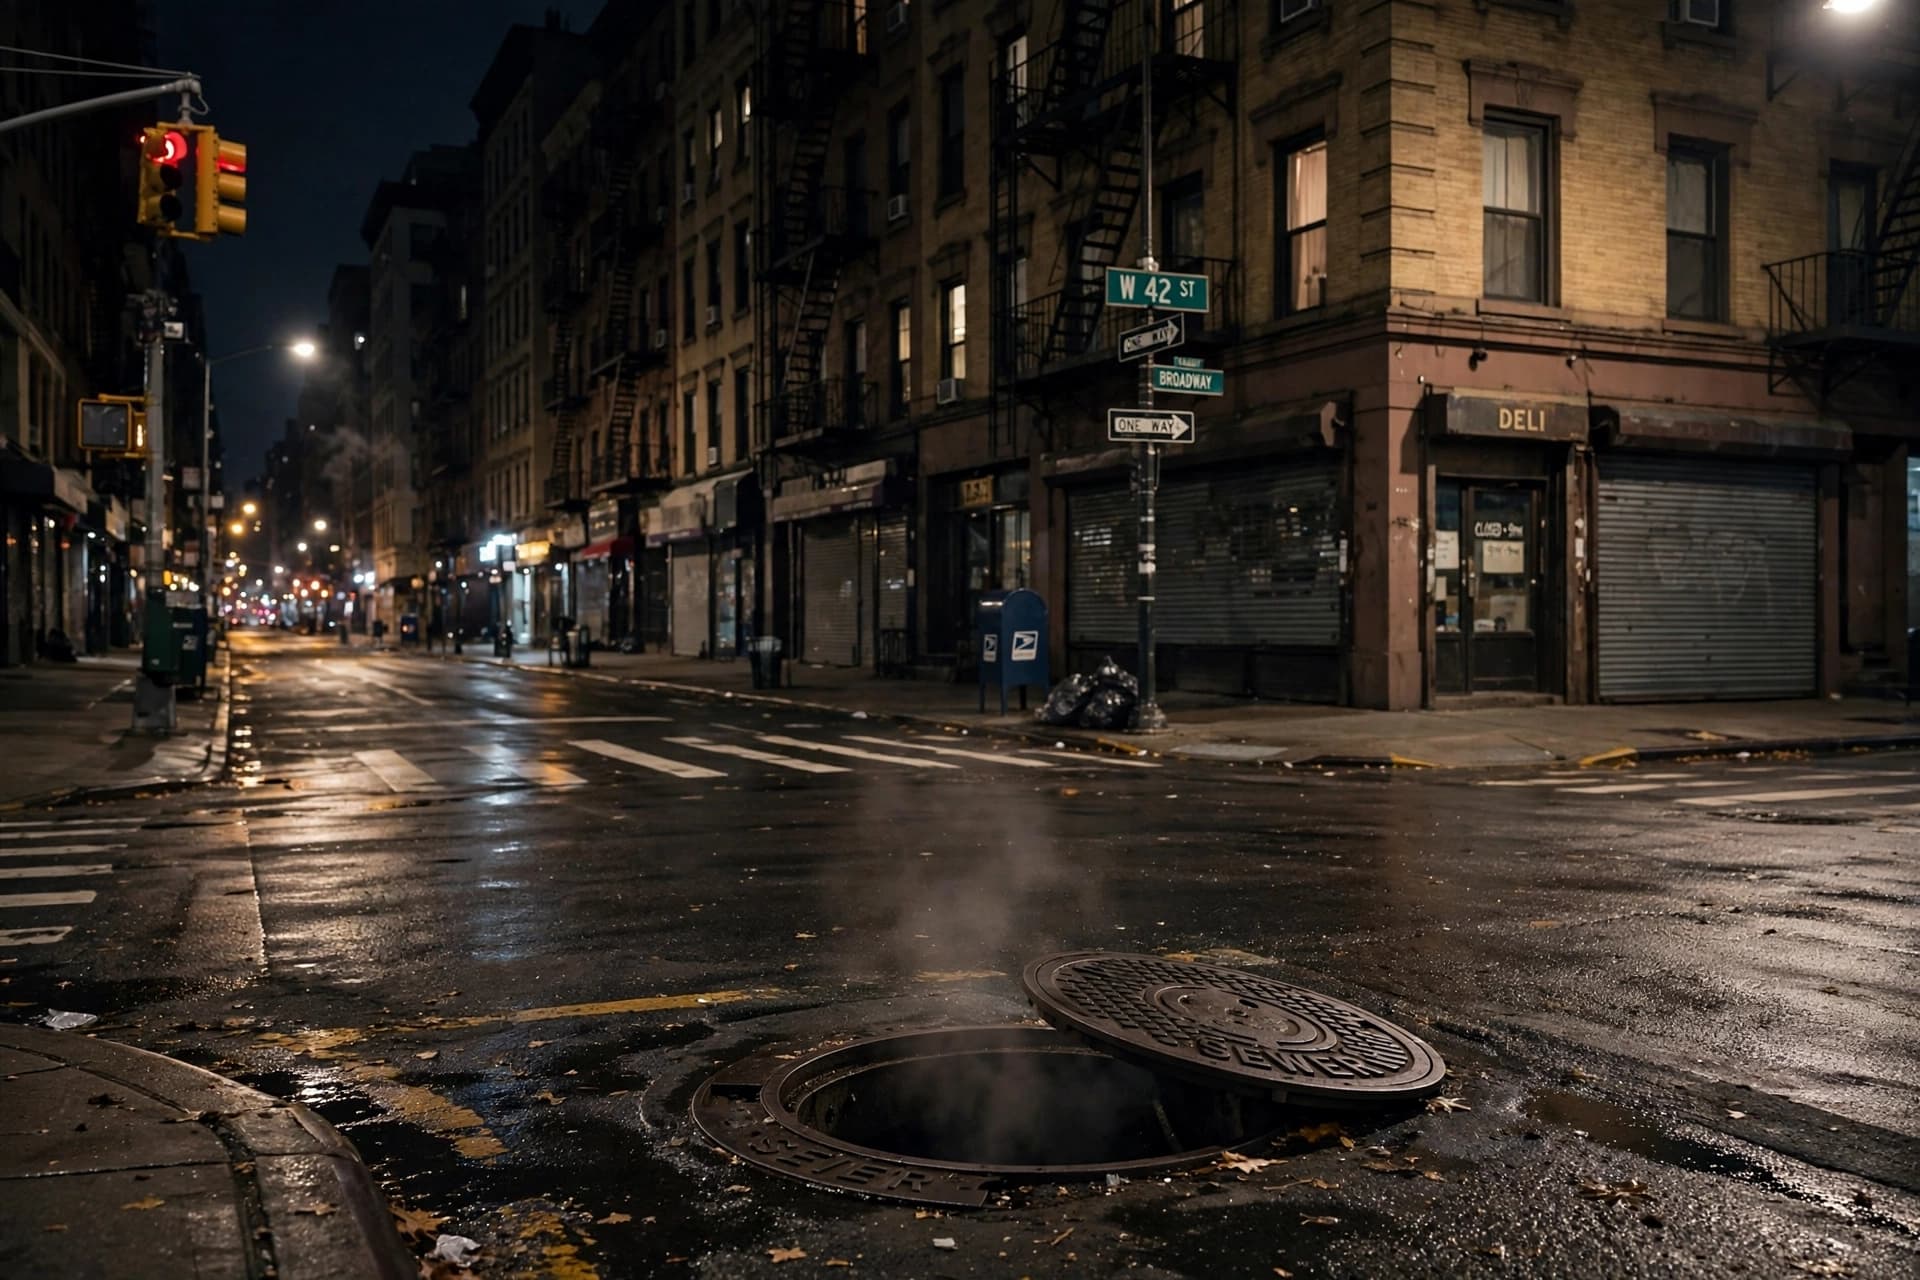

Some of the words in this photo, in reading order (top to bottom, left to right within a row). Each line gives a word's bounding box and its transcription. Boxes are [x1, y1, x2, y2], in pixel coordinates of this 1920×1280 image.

[1120, 274, 1136, 300] W
[1144, 276, 1171, 304] 42
[1180, 280, 1195, 297] ST
[1159, 370, 1213, 390] BROADWAY
[1118, 419, 1140, 431] ONE
[1152, 420, 1174, 432] WAY
[1499, 408, 1545, 432] DELI
[1197, 1036, 1385, 1078] SEWER
